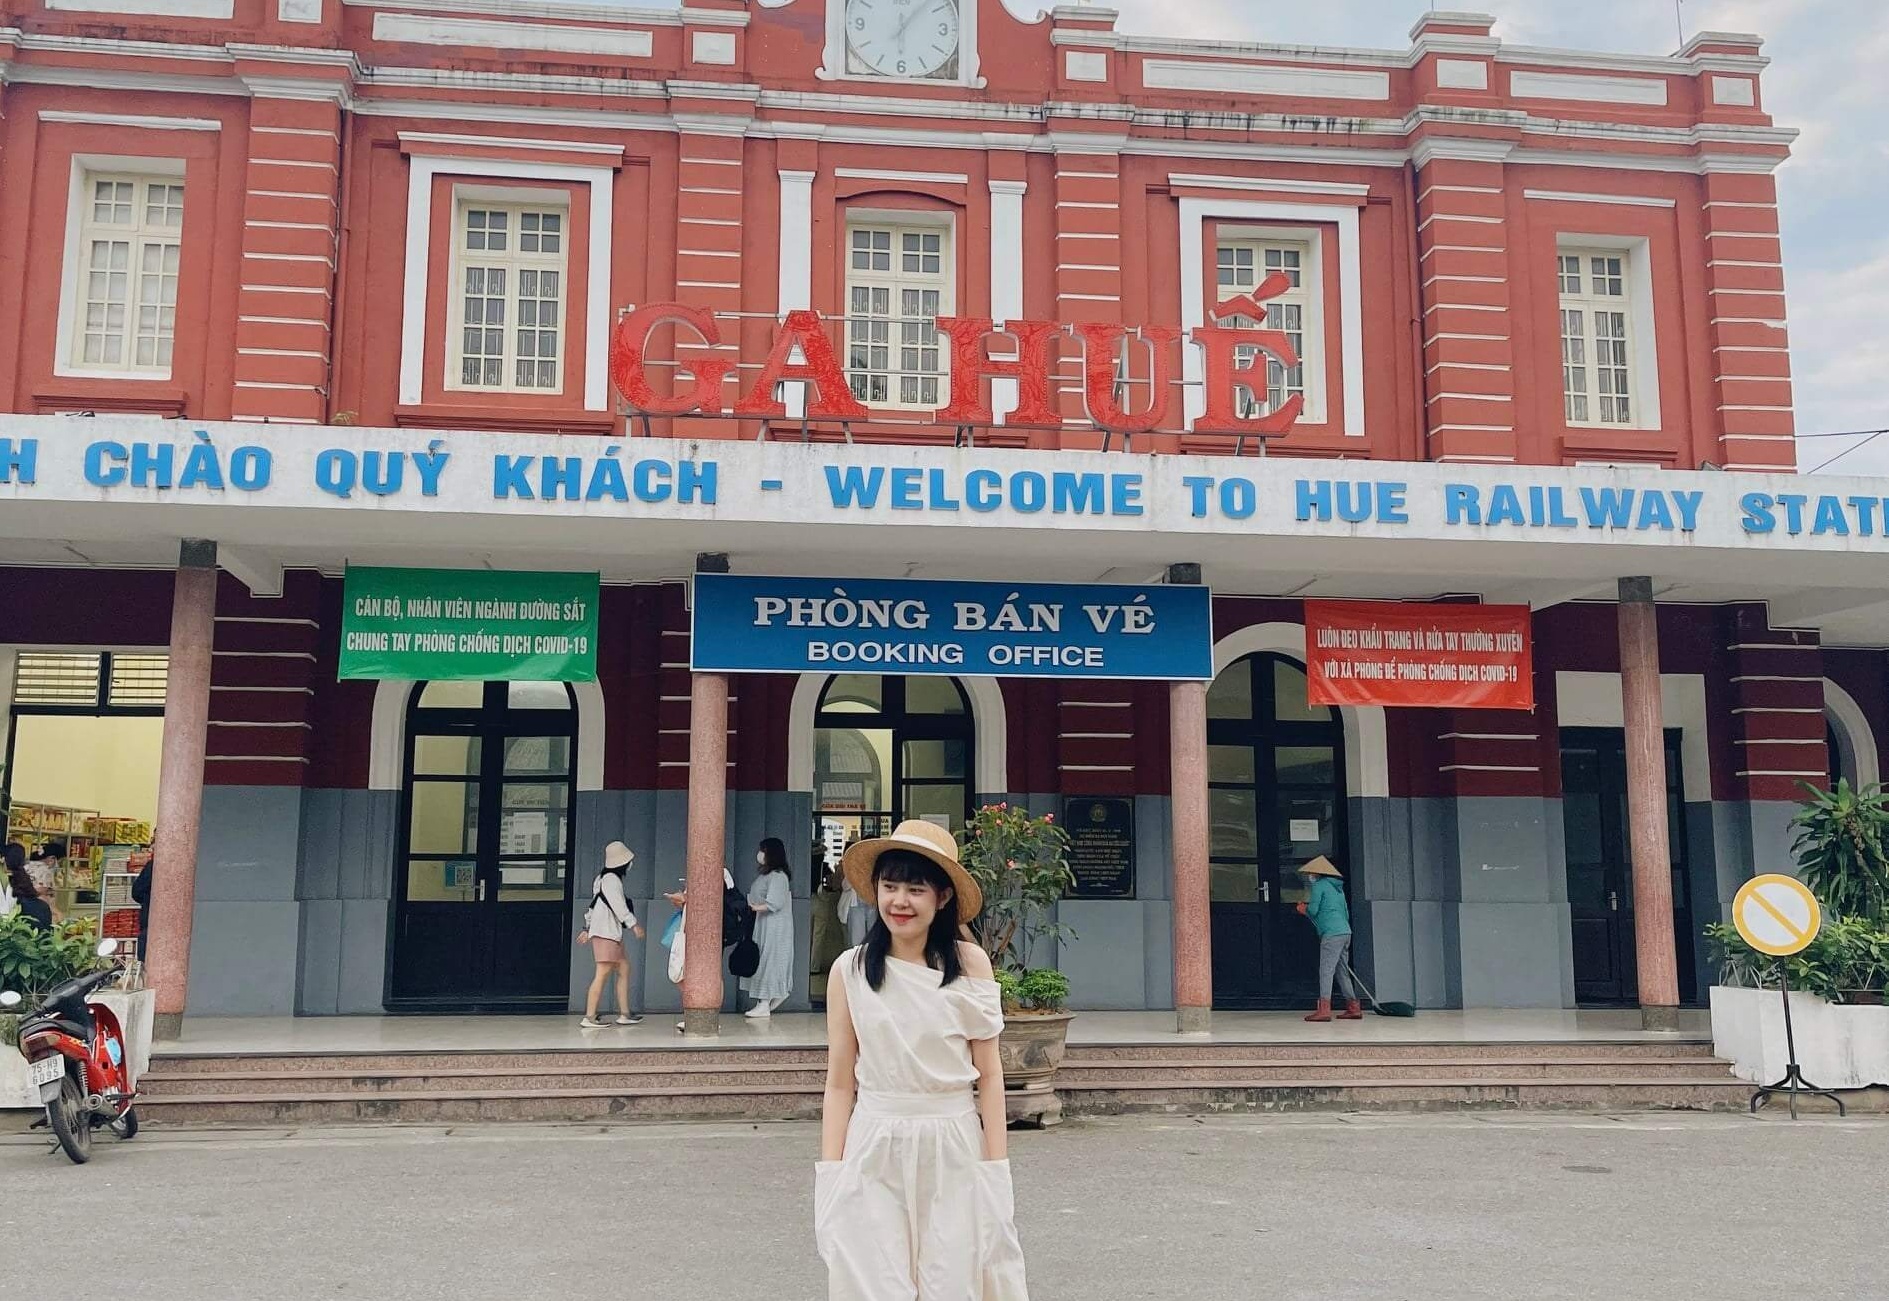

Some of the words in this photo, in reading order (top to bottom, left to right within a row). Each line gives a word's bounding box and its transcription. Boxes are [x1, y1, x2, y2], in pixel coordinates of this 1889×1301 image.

[856, 17, 865, 31] 9
[938, 22, 948, 36] 3
[896, 60, 906, 74] 6
[609, 302, 868, 423] GA
[934, 273, 1306, 438] HUẾ
[84, 430, 272, 491] CHÀO
[315, 440, 450, 498] QUÝ
[494, 446, 717, 505] KHÁCH
[761, 480, 783, 490] -
[824, 466, 1144, 515] WELCOME
[1182, 476, 1256, 519] TO
[1295, 479, 1409, 523] HUE
[1444, 483, 1704, 530] RAILWAY
[355, 594, 381, 617] CÁN
[383, 595, 404, 621] BỘ,
[407, 596, 441, 618] NHÂN
[444, 596, 472, 619] VIÊN
[475, 597, 517, 620] NGÀNH
[519, 598, 560, 621] ĐƯỜNG
[563, 596, 587, 621] SẮT
[753, 588, 930, 629] PHÒNG
[953, 592, 1064, 632] BÁN
[1082, 594, 1156, 634] VÉ
[346, 631, 389, 651] CHUNG
[391, 633, 412, 651] TAY
[414, 629, 456, 652] PHÒNG
[459, 627, 500, 654] CHỐNG
[502, 635, 532, 658] DỊCH
[534, 636, 588, 655] COVID-19
[1317, 625, 1340, 648] LUÔN
[1341, 629, 1358, 649] ĐEO
[1384, 630, 1412, 650] TRANG
[1413, 627, 1425, 651] VÀ
[1445, 632, 1459, 652] TAY
[1460, 628, 1494, 652] THƯỜNG
[1496, 629, 1523, 653] XUYÊN
[808, 641, 964, 664] BOOKING
[988, 645, 1104, 667] OFFICE
[1324, 658, 1339, 679] VỚI
[1354, 658, 1384, 680] PHÒNG
[1398, 659, 1427, 681] PHÒNG
[1428, 658, 1458, 682] CHỐNG
[1459, 664, 1479, 685] DỊCH
[1480, 665, 1518, 682] COVID-19
